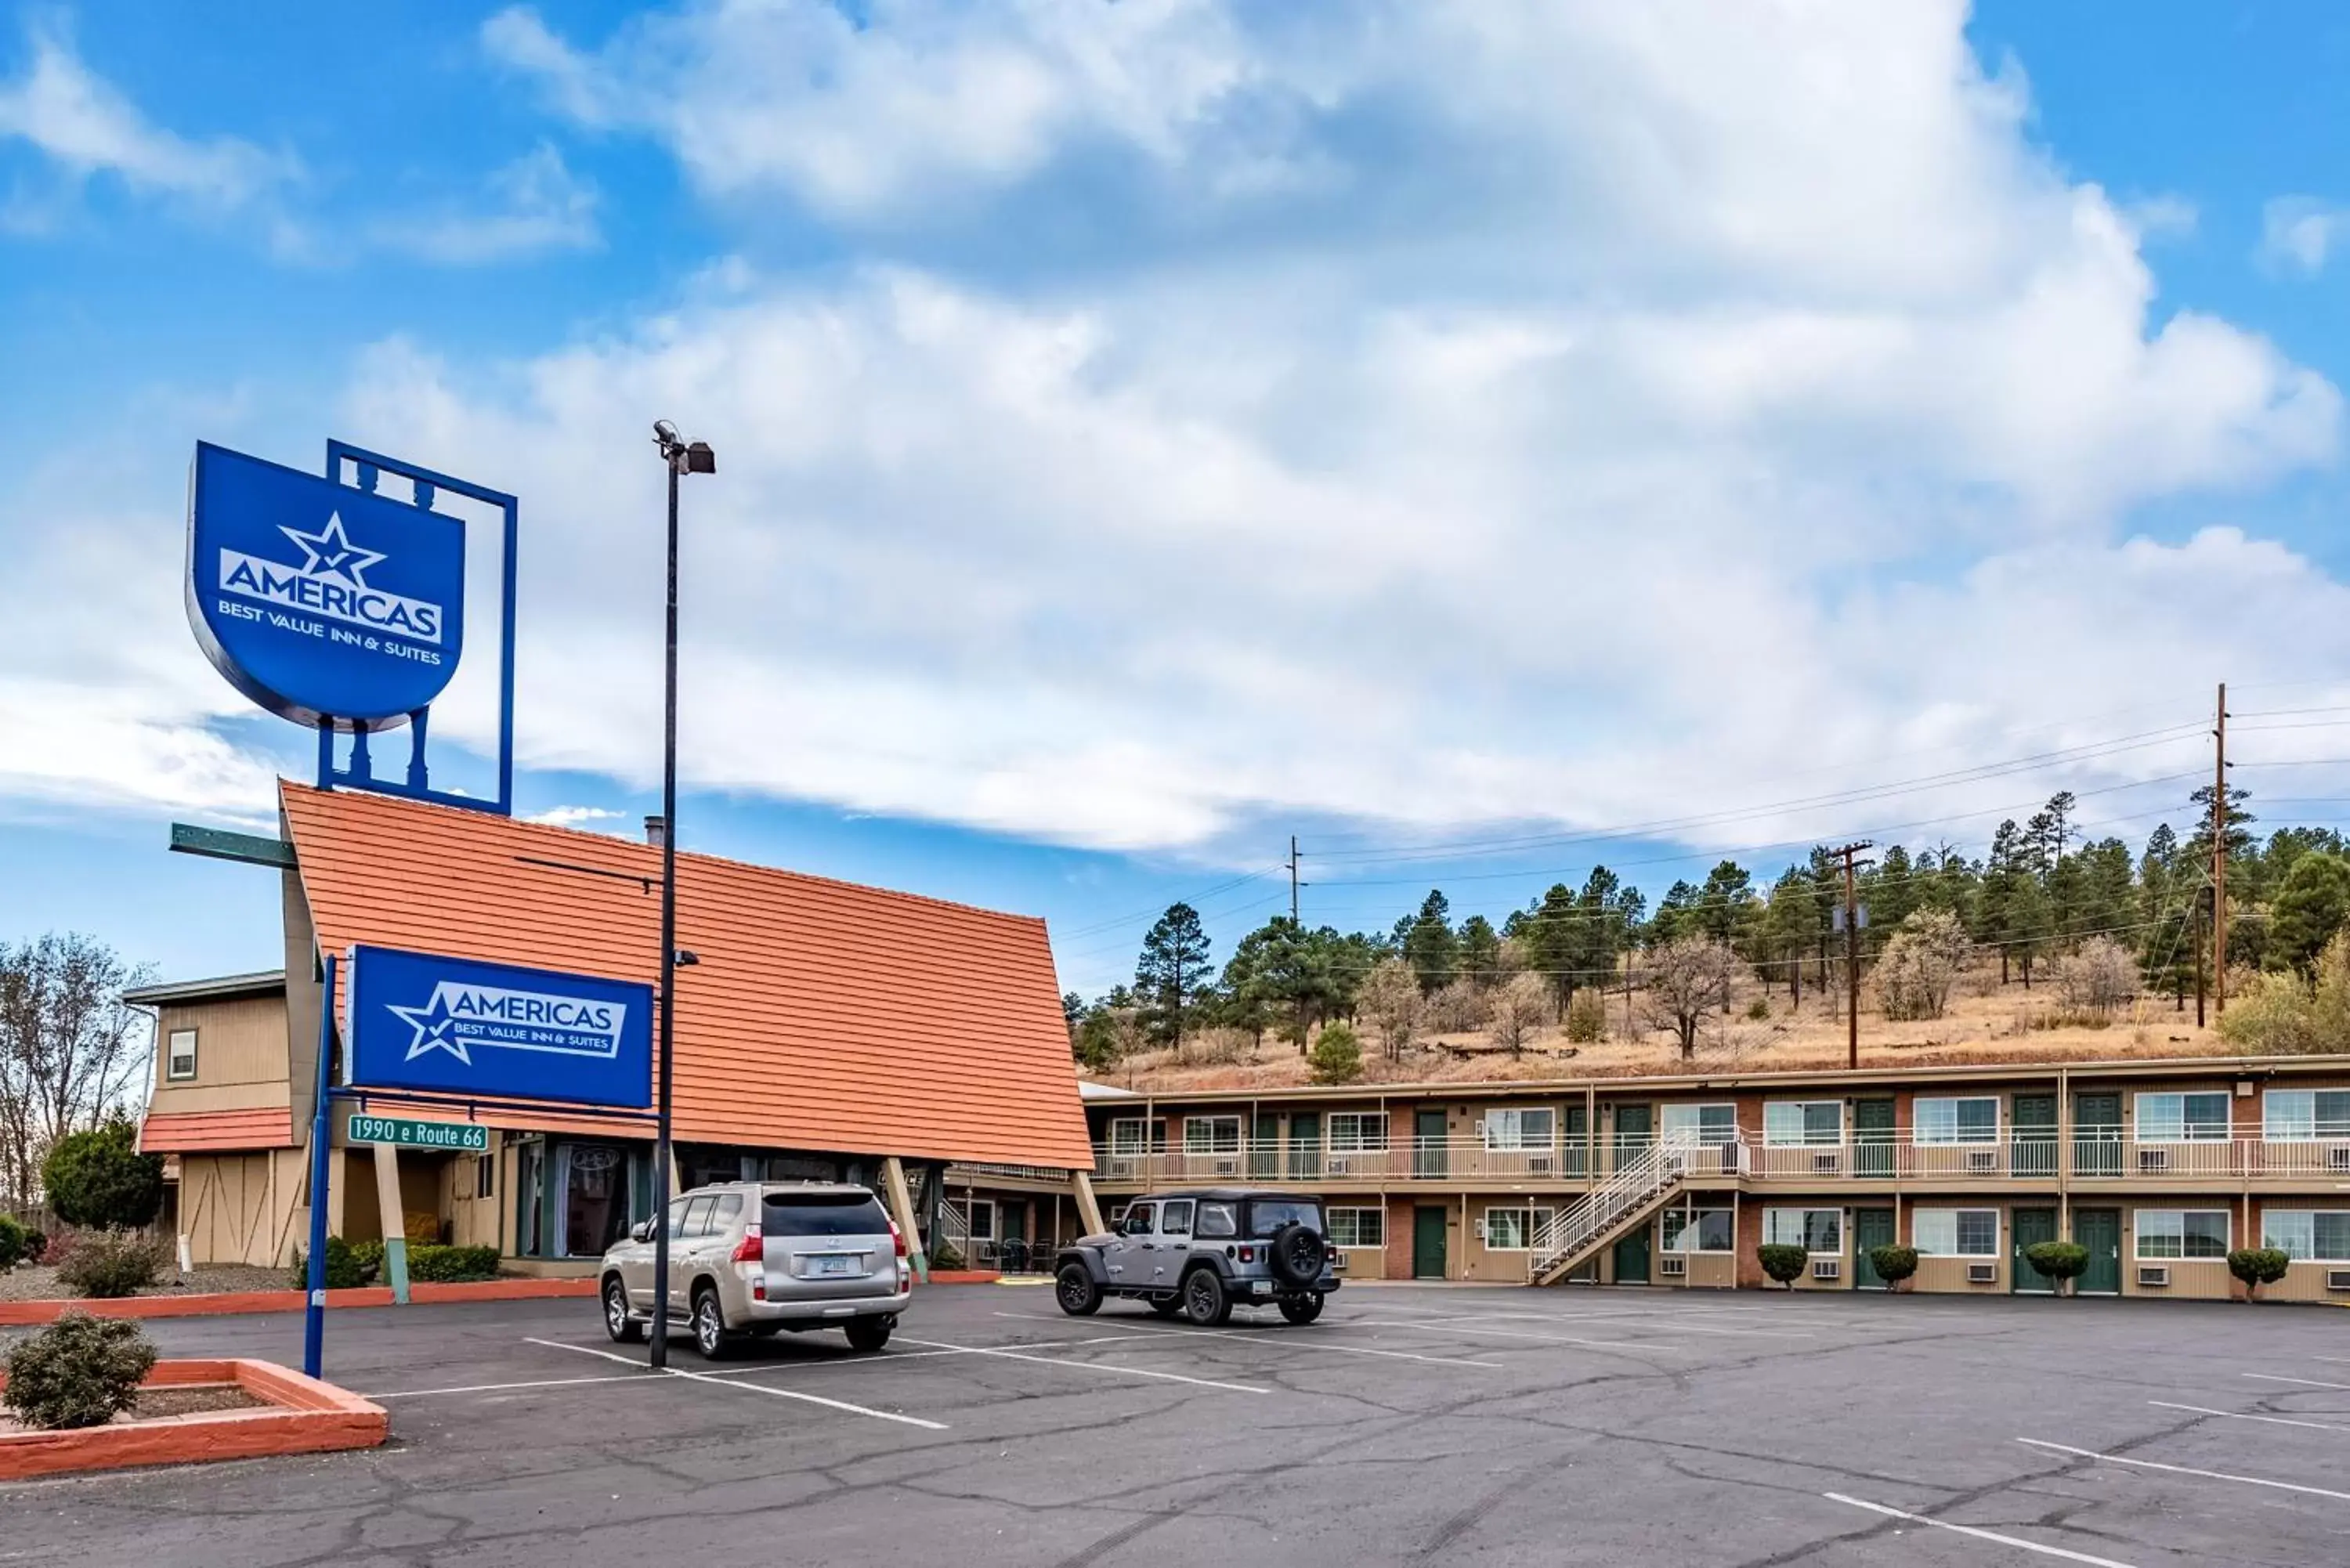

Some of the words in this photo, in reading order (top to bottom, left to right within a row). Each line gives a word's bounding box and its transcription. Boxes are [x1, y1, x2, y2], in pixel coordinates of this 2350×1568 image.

[225, 559, 436, 637] AMERICAS
[219, 600, 264, 622] BEST
[267, 612, 325, 638] VALUE
[331, 627, 362, 647] INN
[364, 637, 380, 651] &
[384, 641, 441, 665] SUITES
[454, 990, 612, 1030] AMERICAS
[454, 1022, 486, 1035] BEST
[488, 1026, 527, 1041] VALUE
[531, 1030, 553, 1042] INN
[555, 1033, 565, 1044] &
[568, 1035, 609, 1049] SUITES
[355, 1119, 395, 1140] 1990
[401, 1127, 410, 1141] e
[417, 1124, 458, 1144] Route
[463, 1129, 482, 1146] 66
